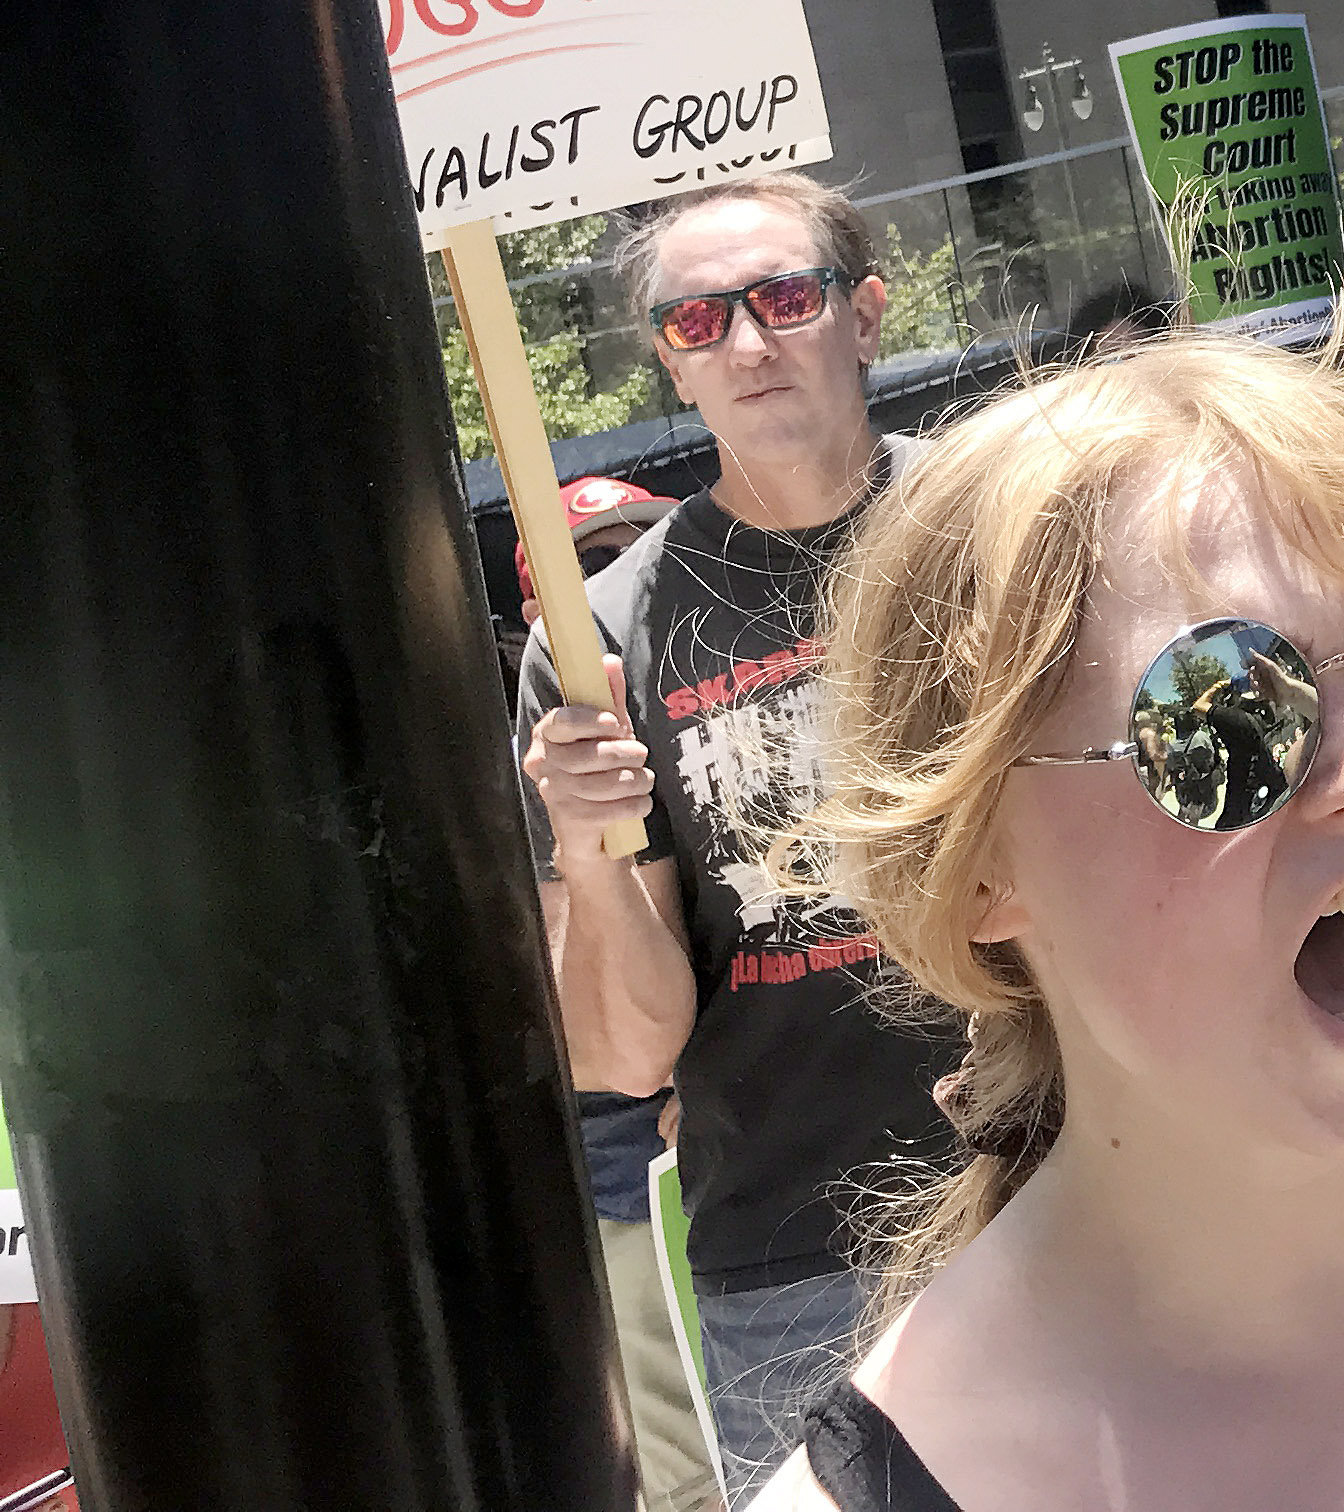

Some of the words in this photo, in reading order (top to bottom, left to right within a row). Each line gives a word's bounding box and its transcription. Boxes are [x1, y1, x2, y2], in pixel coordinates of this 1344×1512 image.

[1154, 42, 1242, 95] STOP
[1251, 39, 1294, 76] the
[632, 74, 799, 160] GROUP
[1161, 87, 1306, 141] Supreme
[1203, 129, 1297, 179] Court
